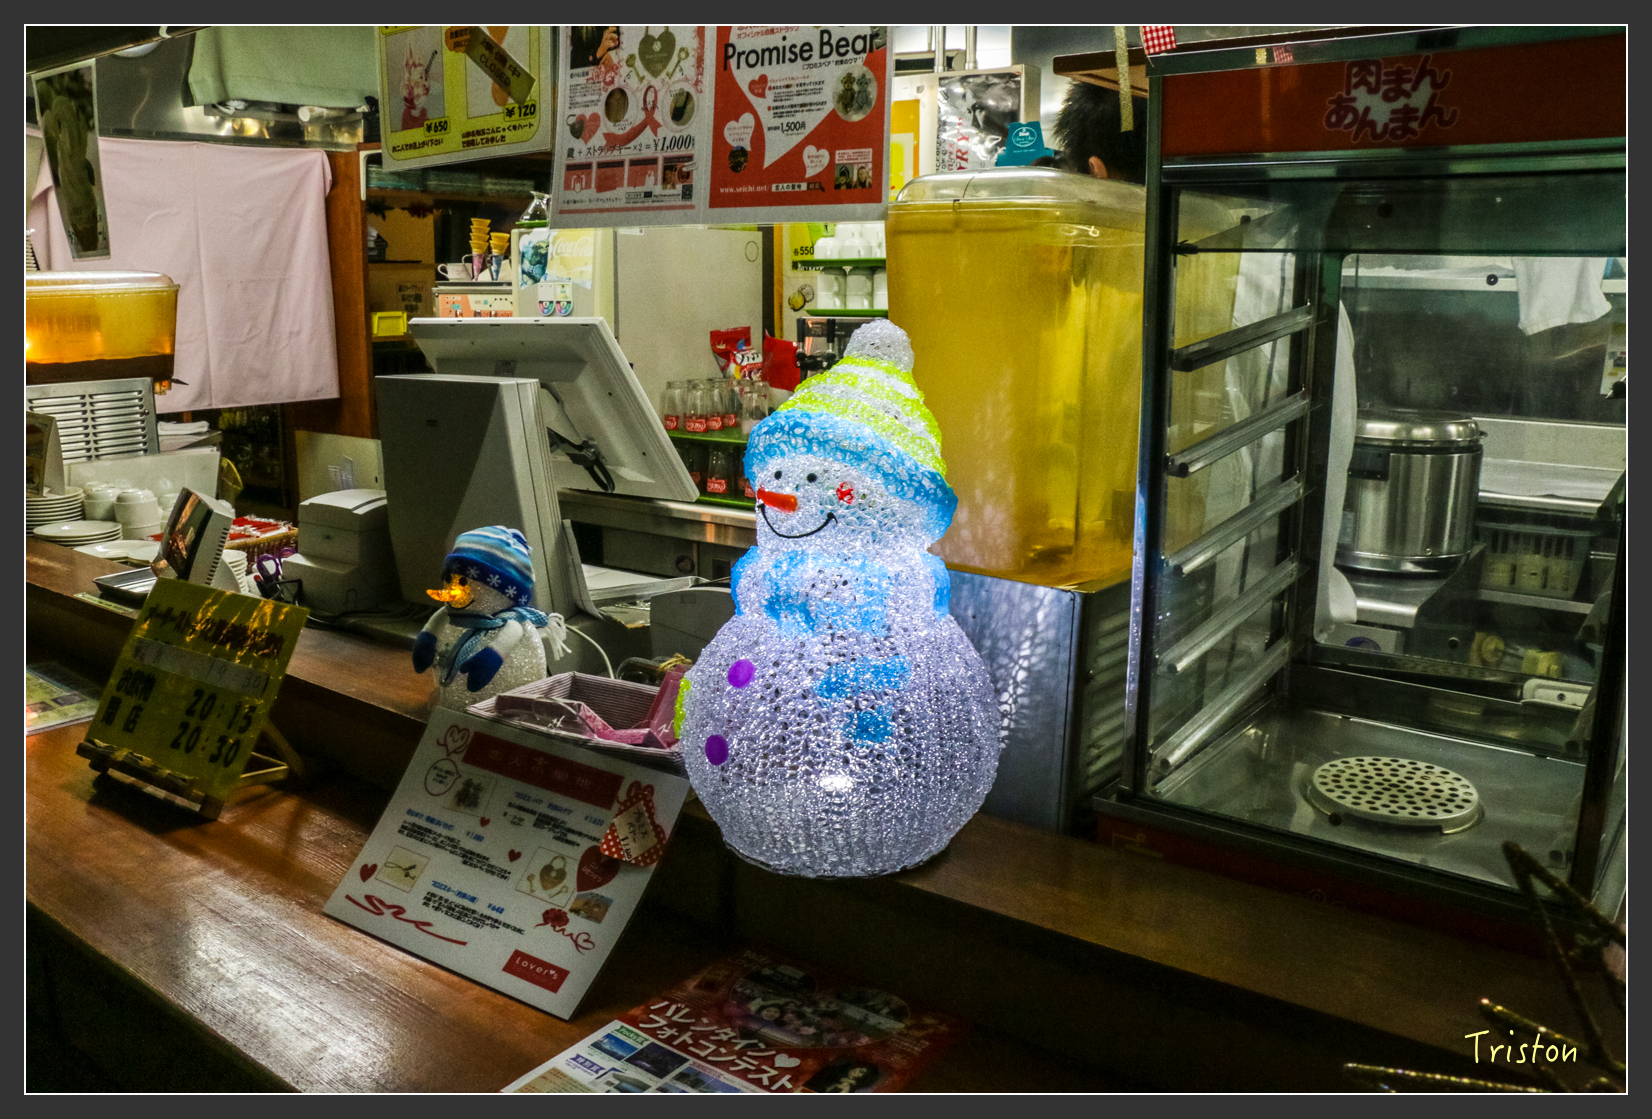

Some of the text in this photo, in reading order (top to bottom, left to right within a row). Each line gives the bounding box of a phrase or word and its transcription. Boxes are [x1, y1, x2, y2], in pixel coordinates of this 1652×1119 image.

[480, 53, 511, 87] CLOSED
[723, 29, 880, 71] Promise Bear
[1346, 54, 1451, 103] 肉まん
[425, 120, 448, 133] ¥650
[505, 104, 536, 118] ¥120
[1324, 92, 1459, 142] あんまん
[653, 134, 693, 151] ¥1,000
[185, 689, 257, 734] 20:15
[170, 722, 241, 768] 20:30
[487, 903, 505, 916] ¥648
[649, 1000, 777, 1057] バレンタイン
[638, 1013, 793, 1091] フォトコンテスト
